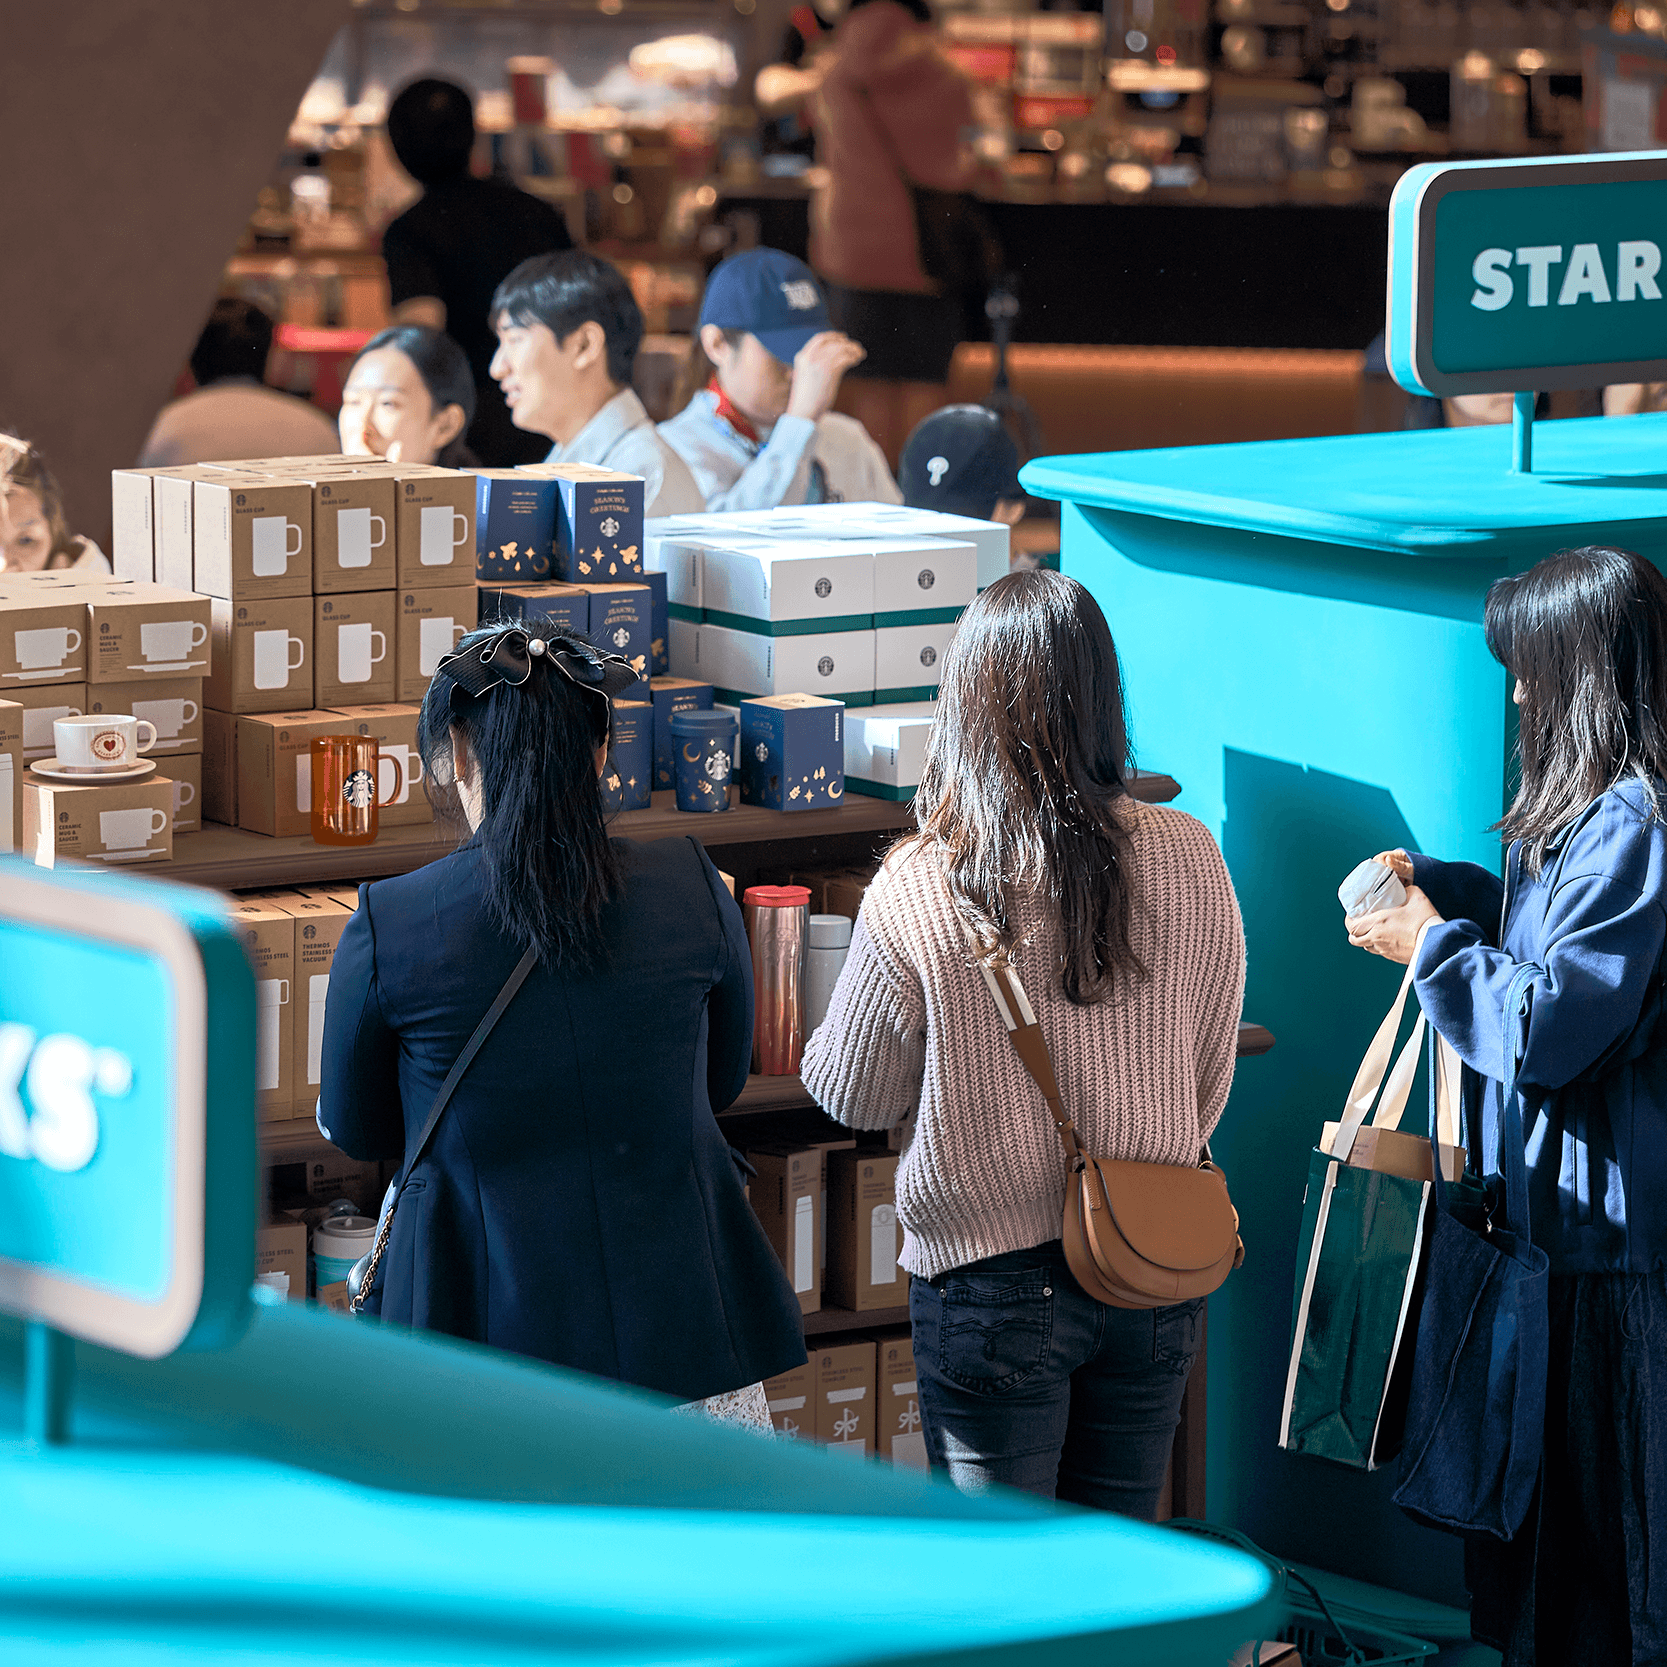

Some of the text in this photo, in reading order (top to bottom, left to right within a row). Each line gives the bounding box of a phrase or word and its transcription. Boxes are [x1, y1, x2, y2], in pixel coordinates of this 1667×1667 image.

[1470, 240, 1663, 312] STAR
[302, 942, 330, 950] THERMOS
[273, 952, 289, 960] STEEL
[302, 949, 332, 957] STAINLESS
